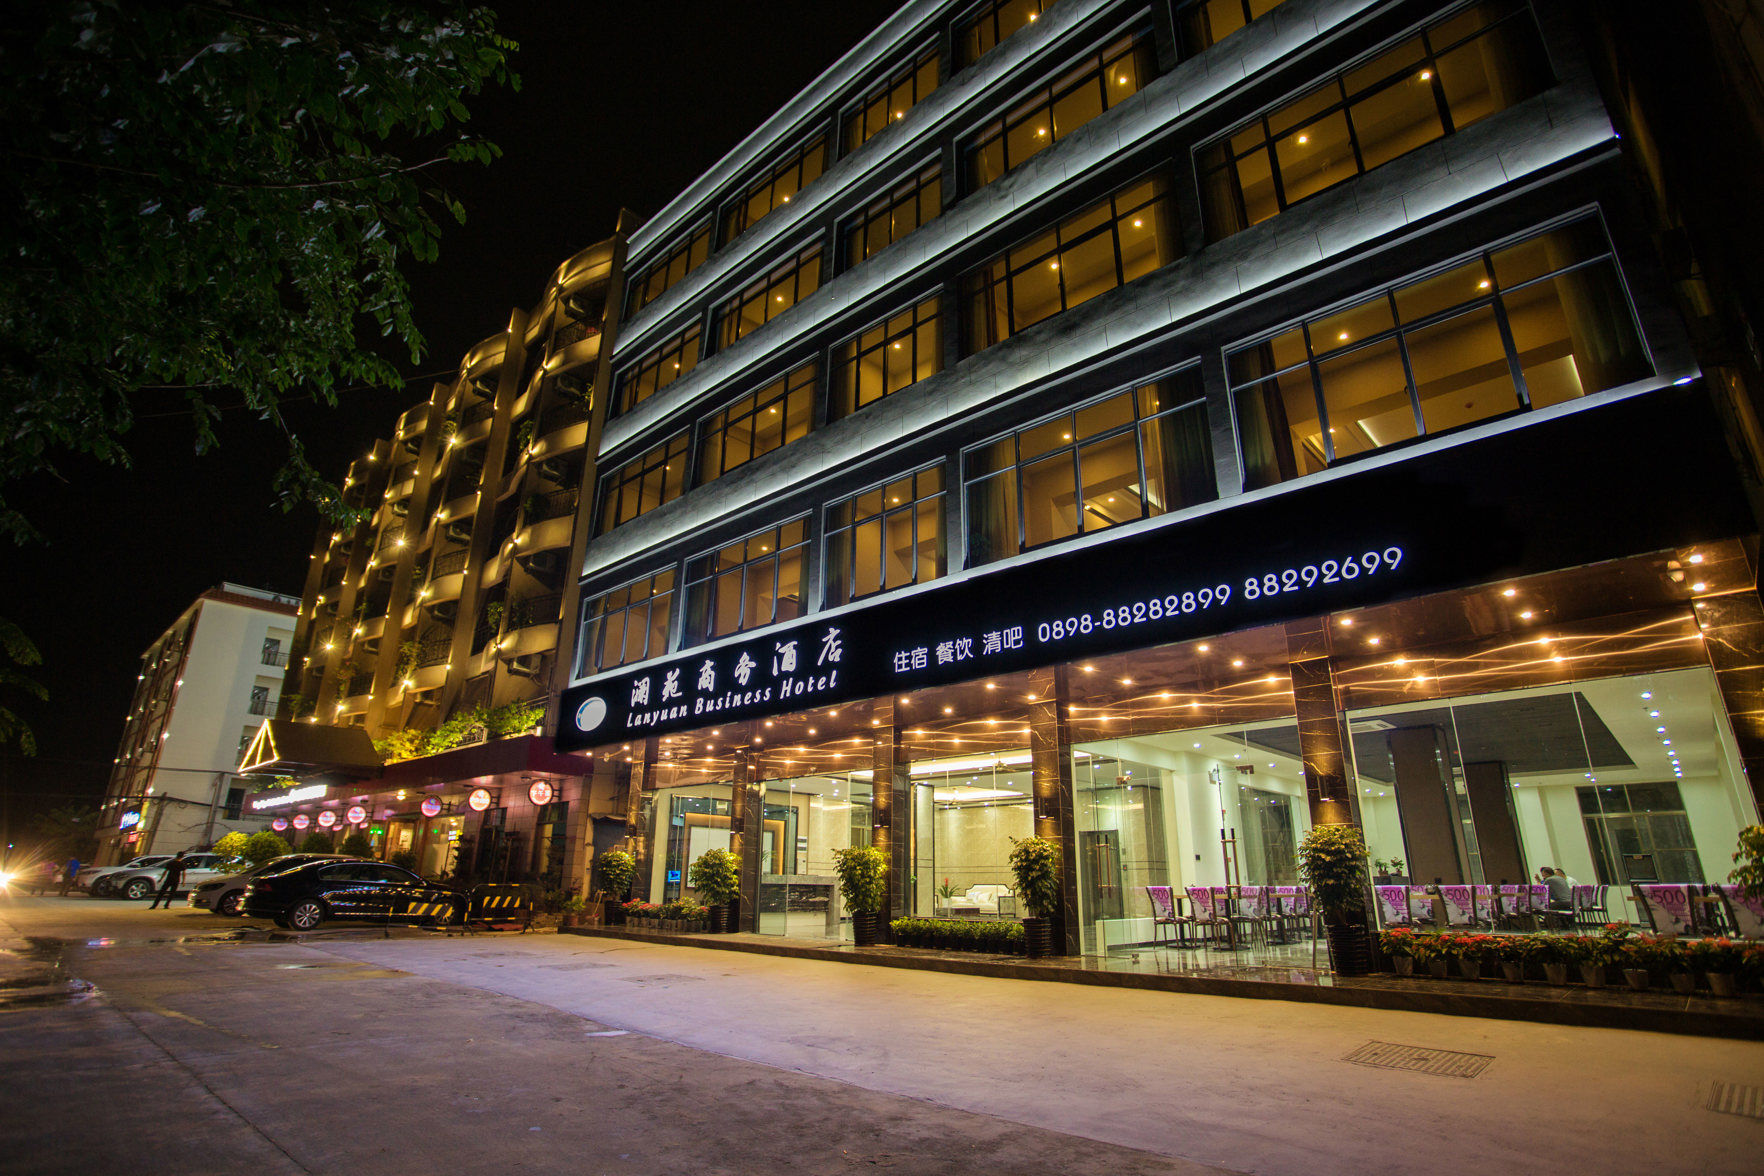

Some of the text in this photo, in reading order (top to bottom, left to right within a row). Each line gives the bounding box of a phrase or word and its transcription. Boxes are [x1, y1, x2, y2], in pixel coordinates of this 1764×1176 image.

[893, 547, 1402, 673] 住宿 餐饮 清吧 0898-88282899 88292699
[626, 670, 837, 728] Lanyuan Business Hotel
[1192, 889, 1209, 900] 500
[1382, 889, 1405, 901] 500
[1446, 888, 1470, 901] 500
[1652, 889, 1686, 904] 500
